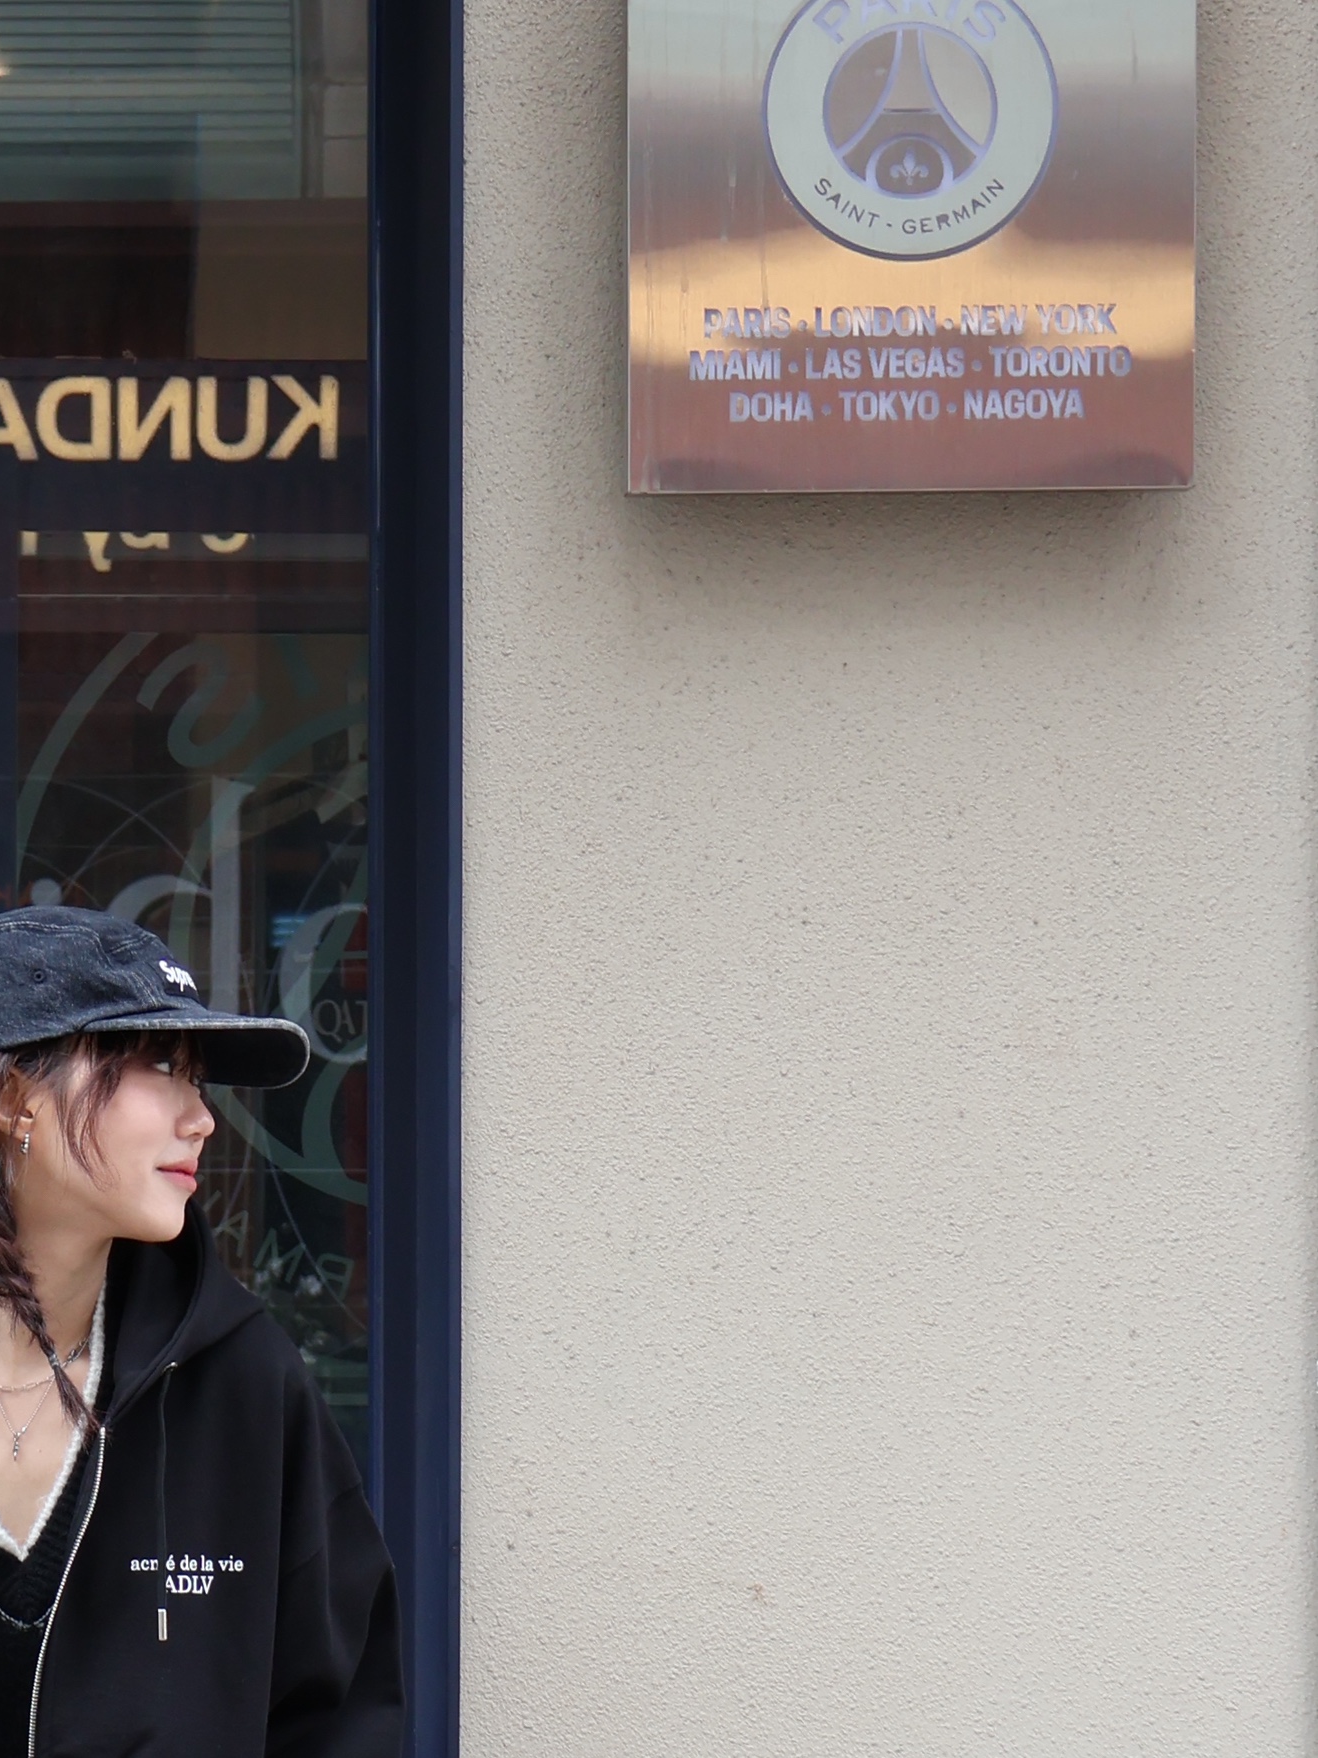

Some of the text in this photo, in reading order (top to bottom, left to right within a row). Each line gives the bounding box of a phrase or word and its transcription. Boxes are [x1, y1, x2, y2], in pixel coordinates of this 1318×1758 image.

[814, 178, 1005, 235] SAINT GERMAIN
[703, 302, 1117, 339] PARIS LONDON NEW YORK
[688, 345, 1132, 381] MIAMI LAS VEGAS TORONTO
[728, 388, 1086, 423] DOHA TOKYO NAGOYA
[179, 1554, 198, 1572] de
[200, 1555, 214, 1572] la
[217, 1555, 245, 1572] vie
[165, 1574, 215, 1595] ADLV
